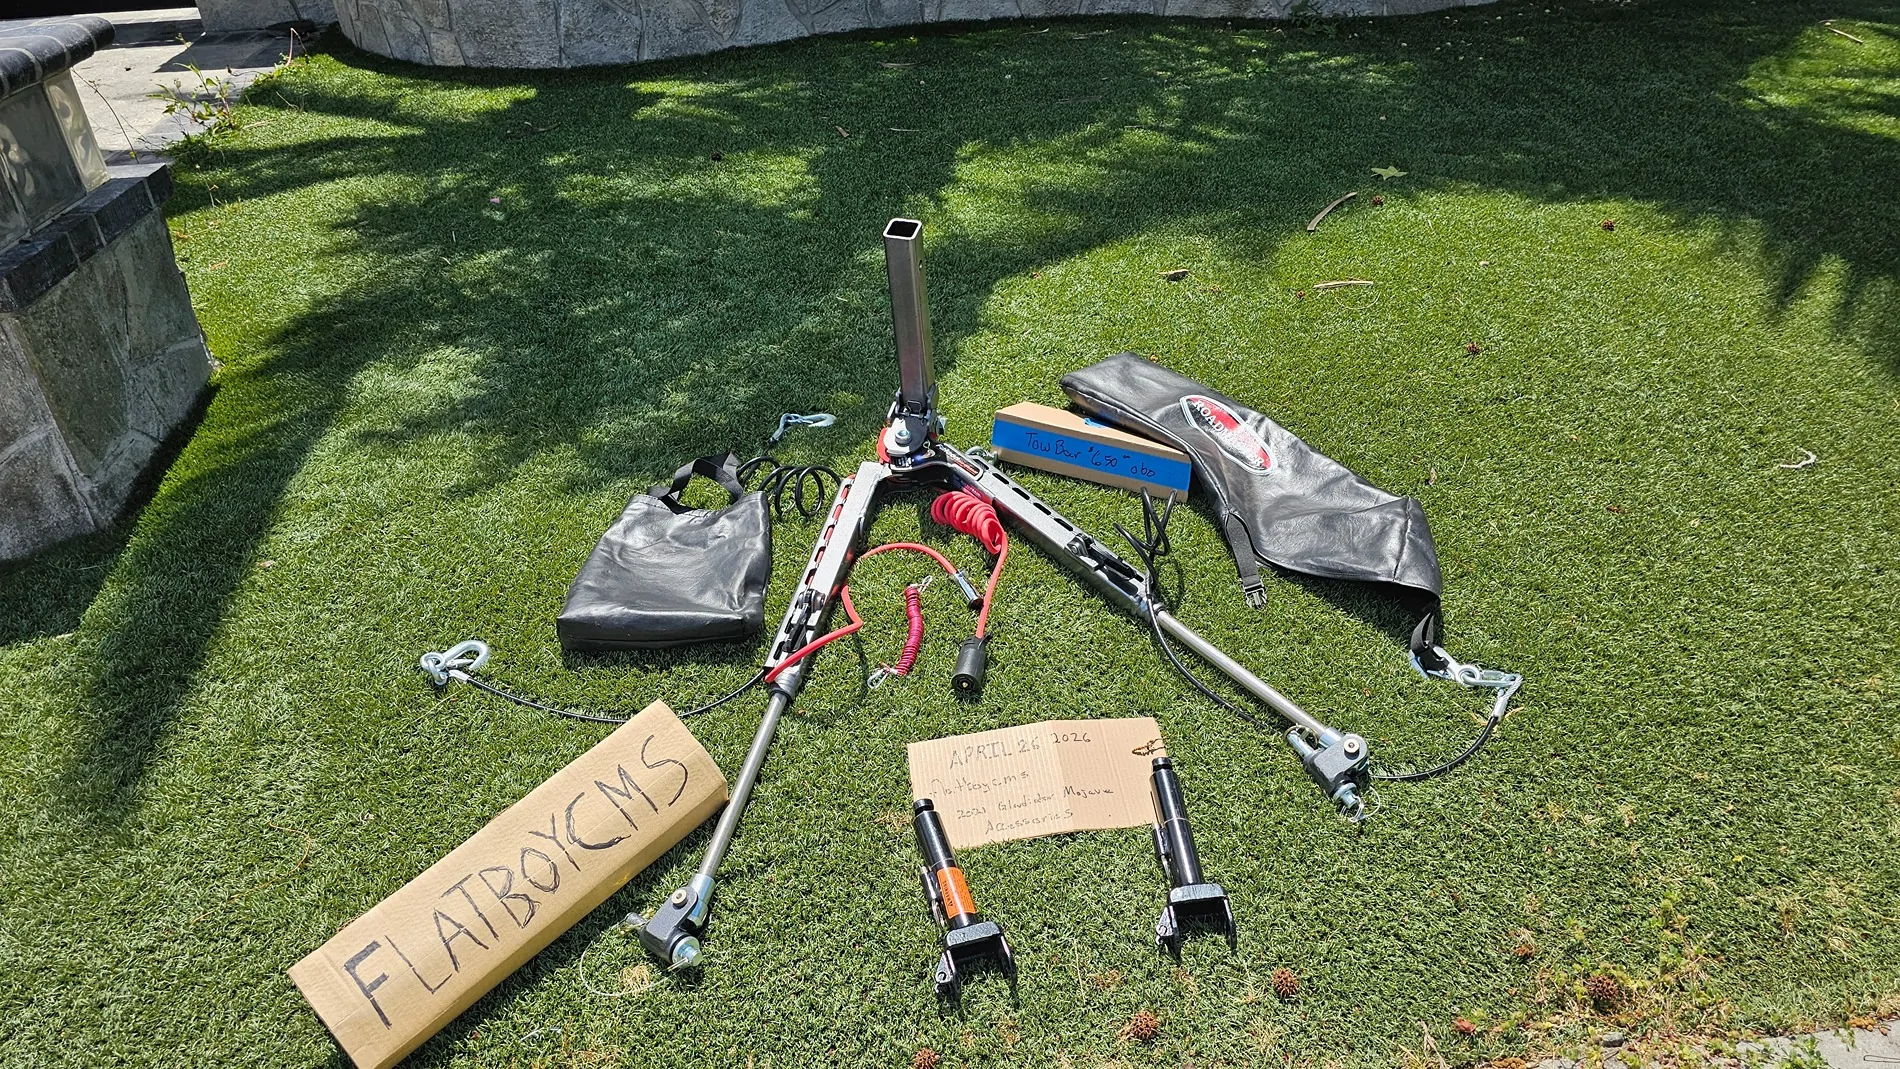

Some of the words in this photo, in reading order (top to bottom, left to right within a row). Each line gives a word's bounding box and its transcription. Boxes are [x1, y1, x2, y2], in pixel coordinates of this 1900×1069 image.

[1026, 432, 1051, 452] Tow
[1055, 439, 1080, 459] Bar
[1130, 461, 1156, 477] obo
[1192, 400, 1265, 468] ROADMAER
[949, 741, 1012, 770] APRIL
[1017, 736, 1040, 753] 26
[1051, 732, 1091, 745] 2026
[344, 735, 690, 1030] FLATBOYCMS
